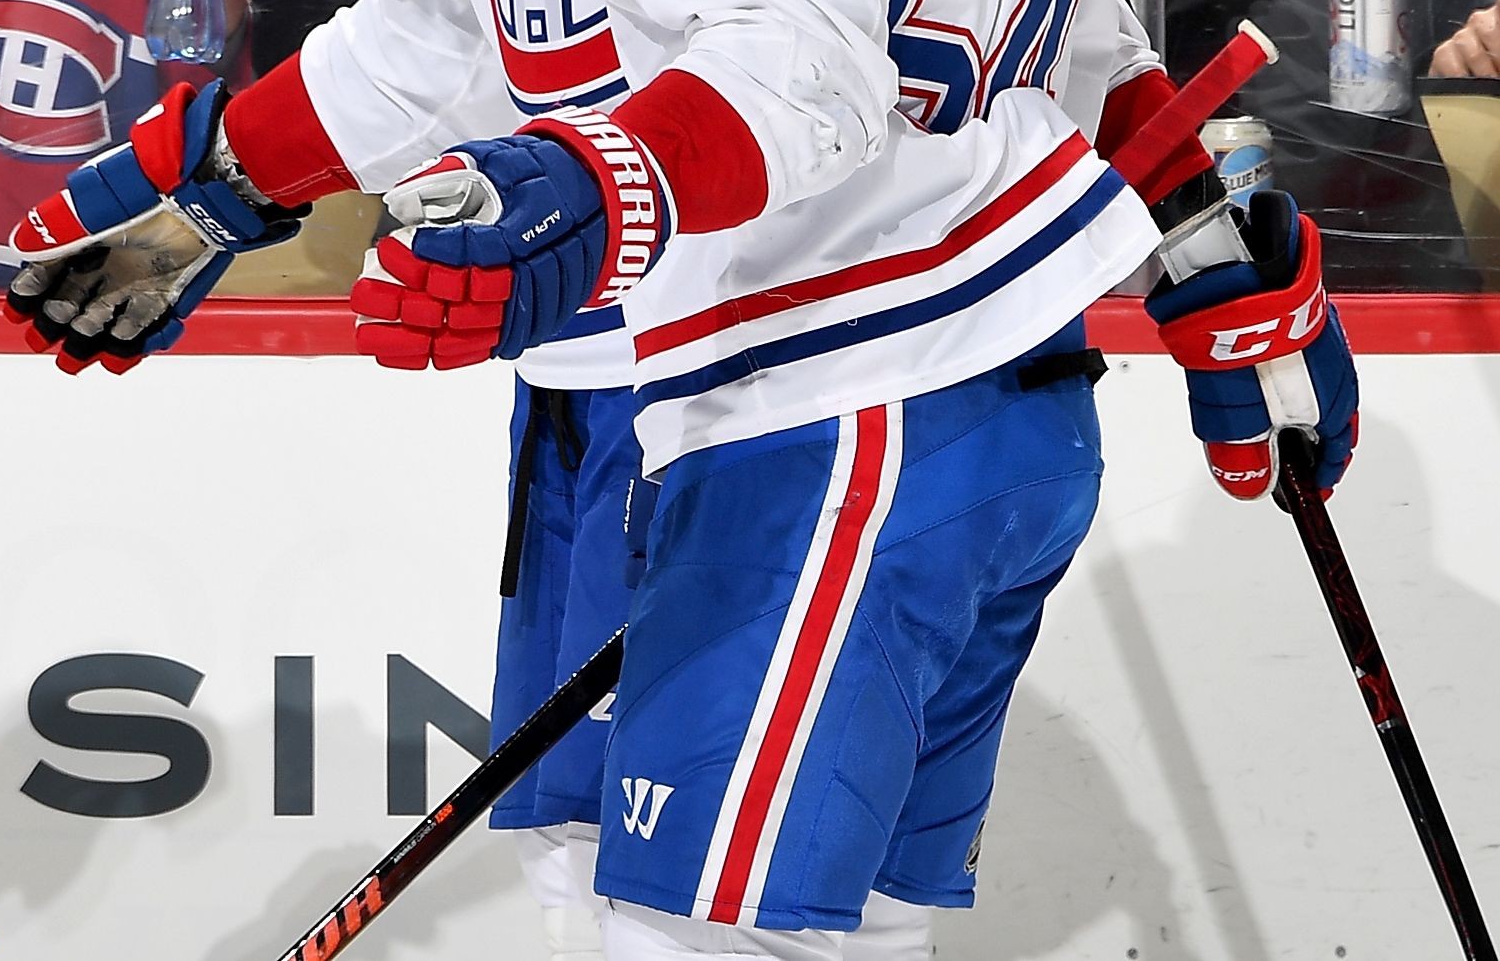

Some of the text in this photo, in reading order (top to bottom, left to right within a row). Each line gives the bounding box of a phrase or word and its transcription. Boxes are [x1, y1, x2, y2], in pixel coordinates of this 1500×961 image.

[28, 206, 58, 245] CM
[521, 209, 562, 243] ALPHA
[546, 104, 653, 301] WARRIOR
[1209, 278, 1328, 361] CC
